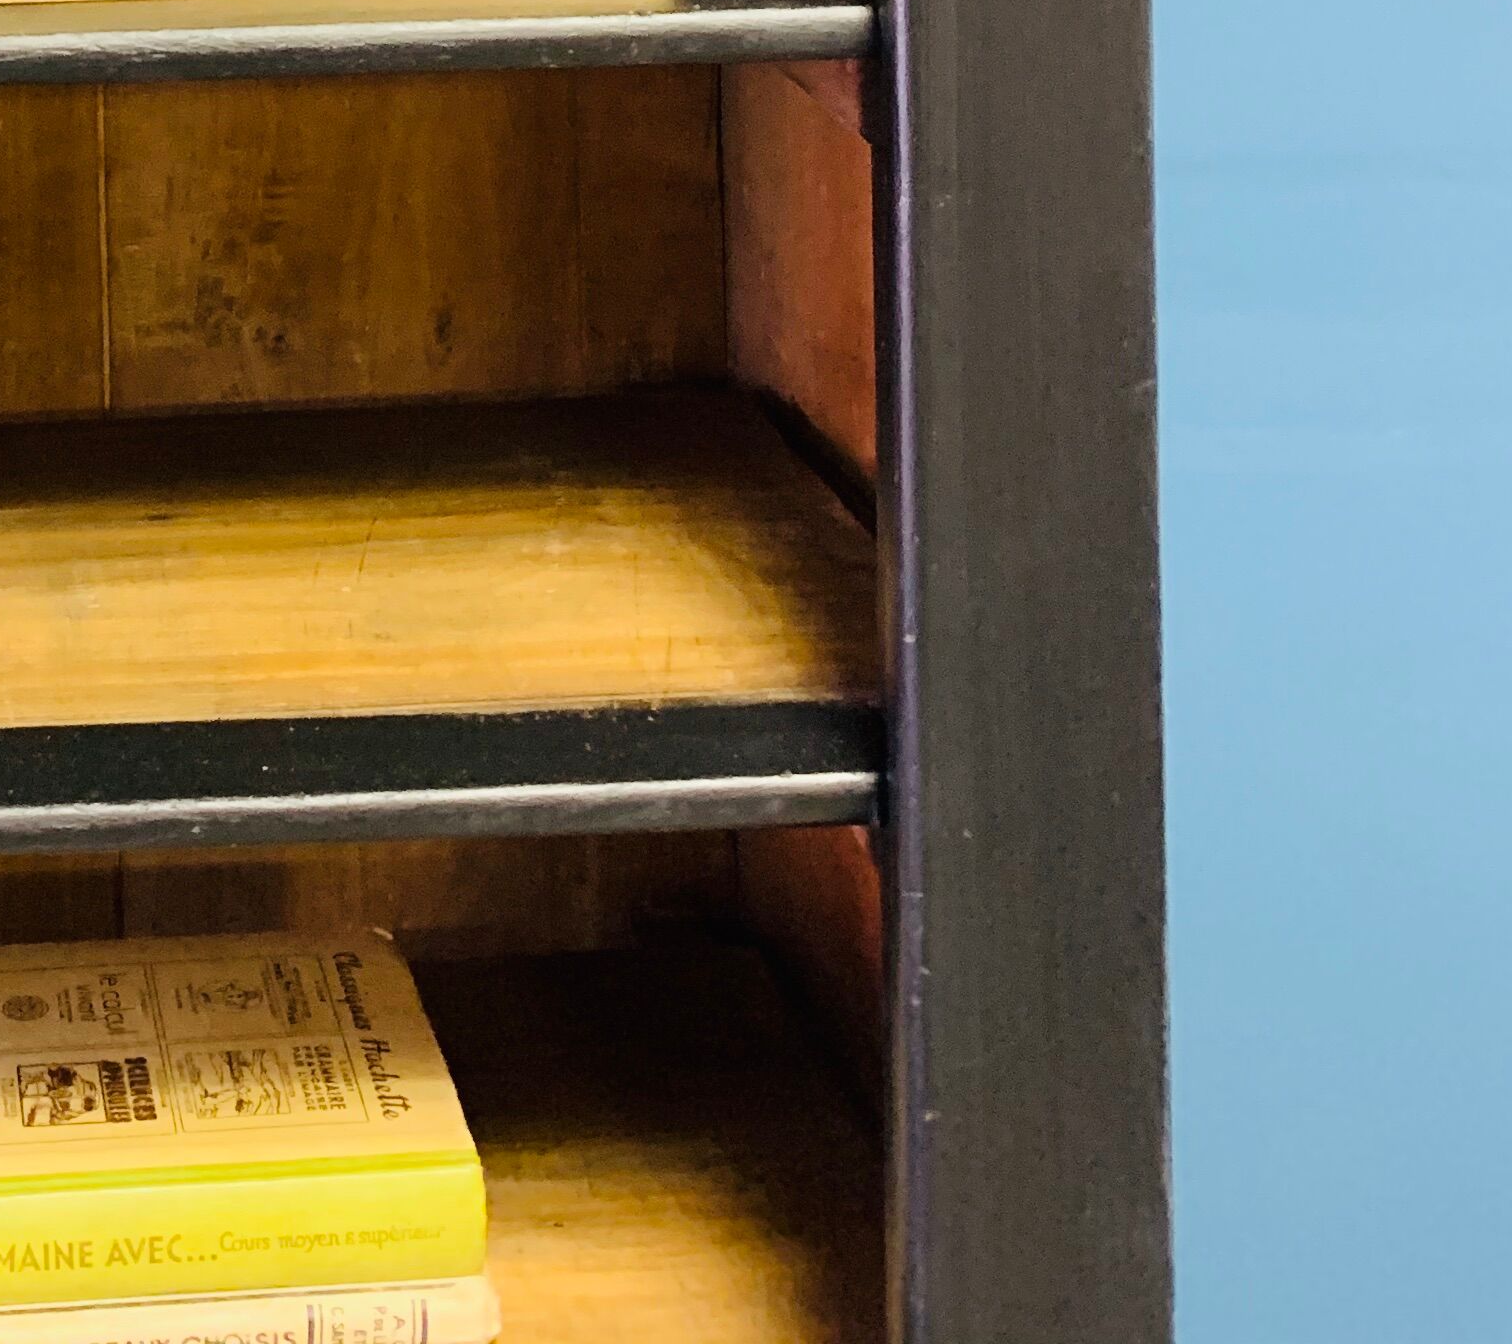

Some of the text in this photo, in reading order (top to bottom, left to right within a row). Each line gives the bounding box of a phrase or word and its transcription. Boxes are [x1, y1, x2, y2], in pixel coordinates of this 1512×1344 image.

[314, 1044, 347, 1111] GRAMMAIRE
[359, 1039, 412, 1120] Hachette
[219, 1231, 271, 1253] Cours
[277, 1231, 340, 1254] moyen
